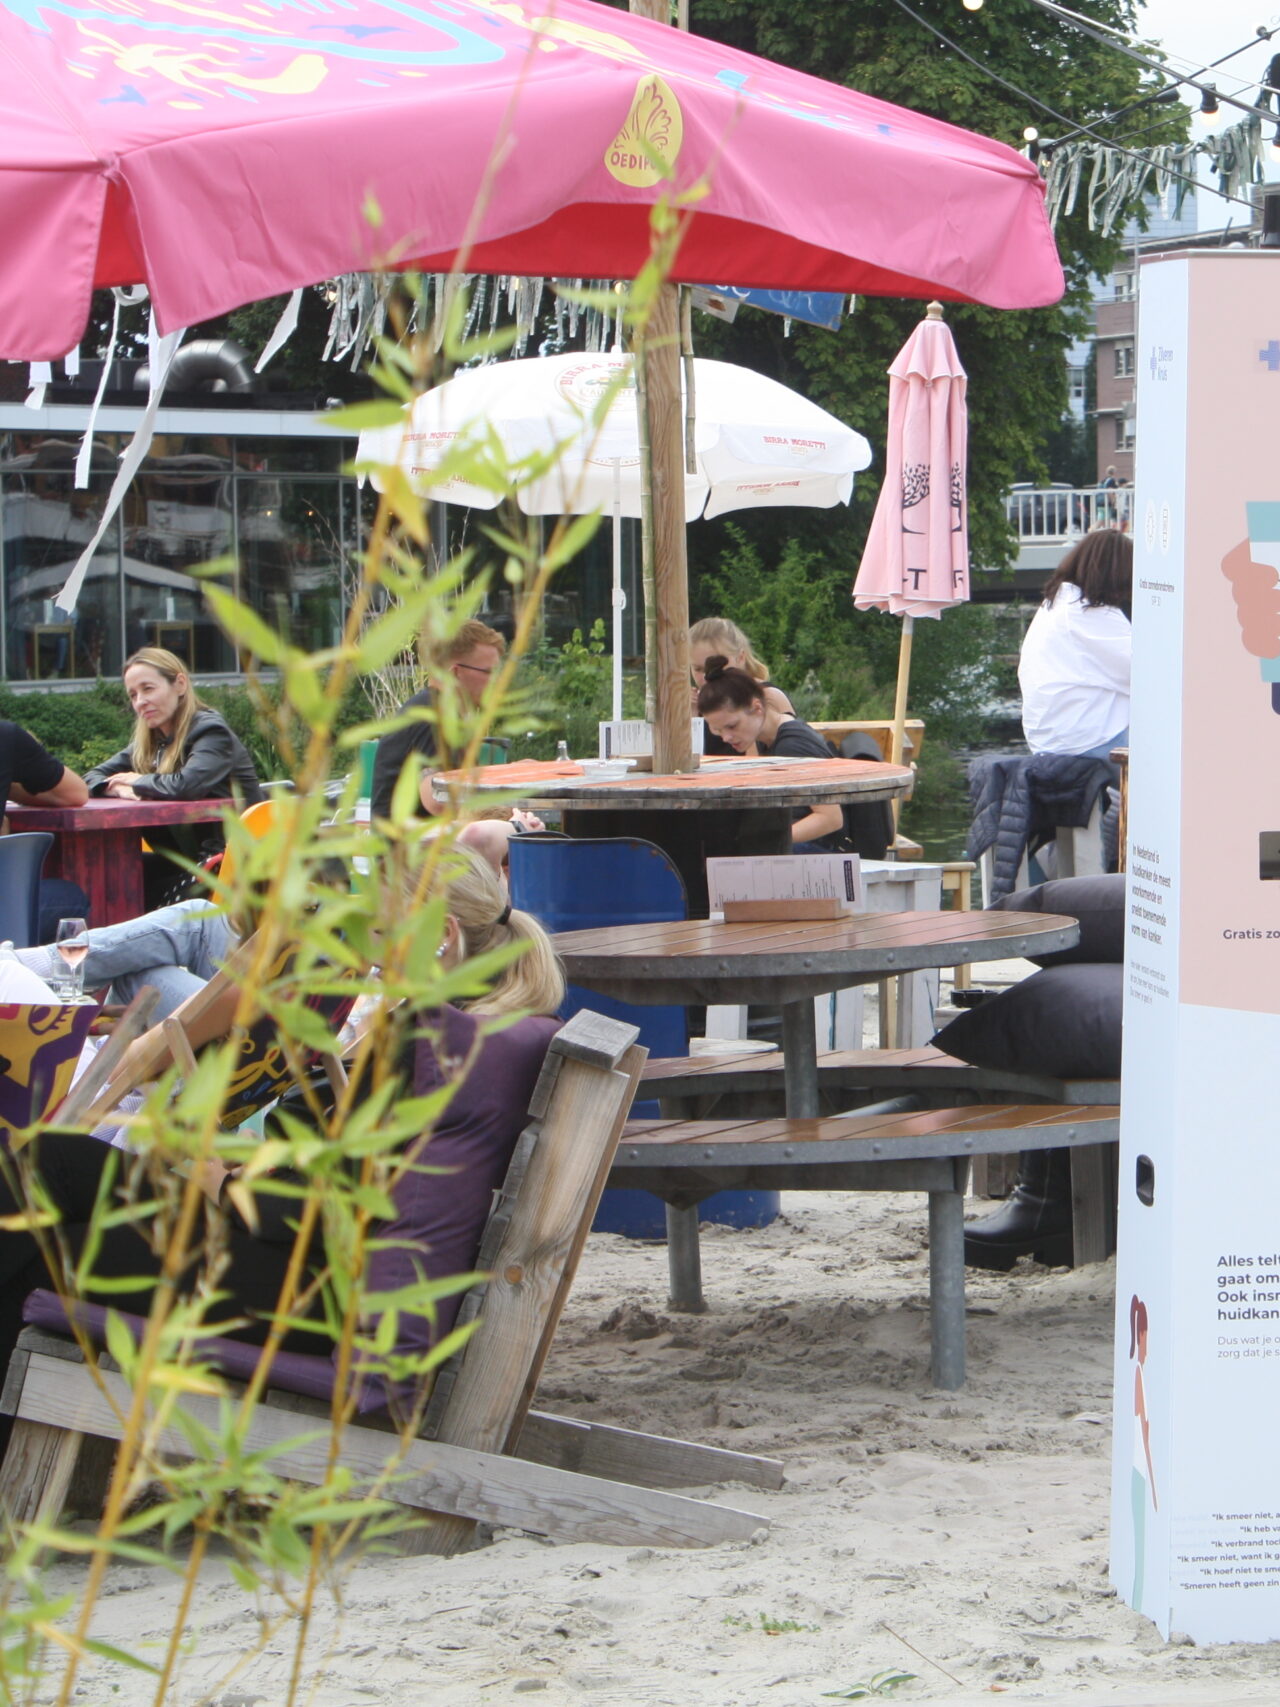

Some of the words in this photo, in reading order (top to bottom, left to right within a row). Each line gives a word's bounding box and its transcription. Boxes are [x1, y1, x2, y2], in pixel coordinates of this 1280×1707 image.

[1223, 928, 1262, 940] Gratis
[1217, 1255, 1254, 1267] Alles
[1217, 1274, 1252, 1287] gaat
[1256, 1273, 1280, 1284] om
[1217, 1290, 1248, 1303] Ook
[1217, 1336, 1238, 1345] Dus
[1241, 1336, 1259, 1345] wat
[1261, 1334, 1272, 1346] je
[1217, 1350, 1240, 1359] zorg
[1243, 1348, 1260, 1358] dat
[1262, 1348, 1272, 1358] je
[1255, 1512, 1273, 1520] niet,
